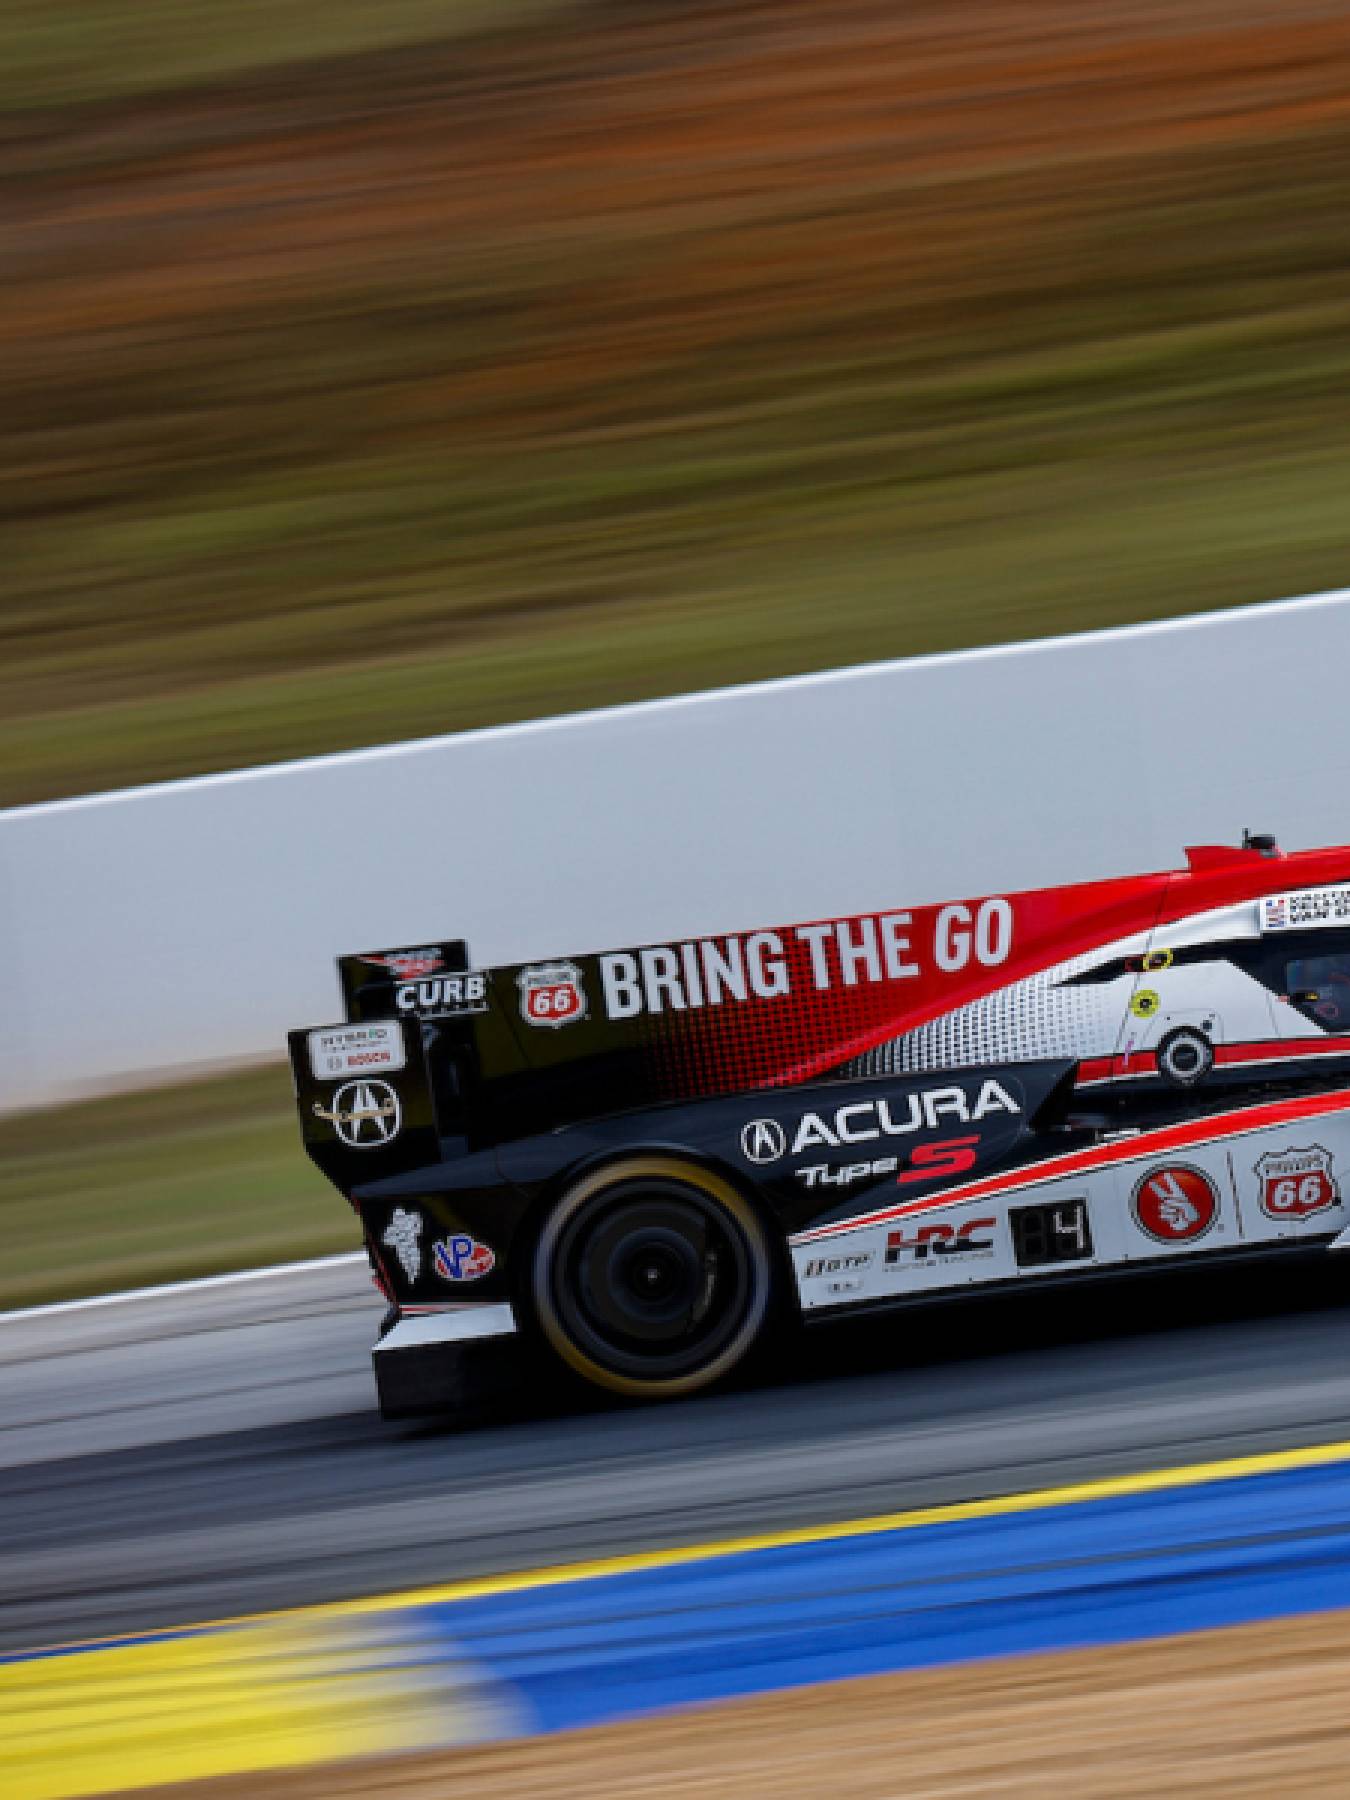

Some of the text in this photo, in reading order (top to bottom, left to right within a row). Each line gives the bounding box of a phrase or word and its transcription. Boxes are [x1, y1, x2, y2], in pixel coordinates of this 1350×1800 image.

[1290, 911, 1329, 924] VAN
[602, 899, 1015, 1019] BRING THE GO
[398, 976, 487, 1009] CURB
[534, 989, 572, 1014] 66
[792, 1079, 1022, 1154] ACURA
[897, 1134, 981, 1184] S
[1273, 1176, 1322, 1208] 66
[884, 1217, 998, 1264] HRC
[1053, 1203, 1085, 1249] 4
[436, 1238, 472, 1279] VP
